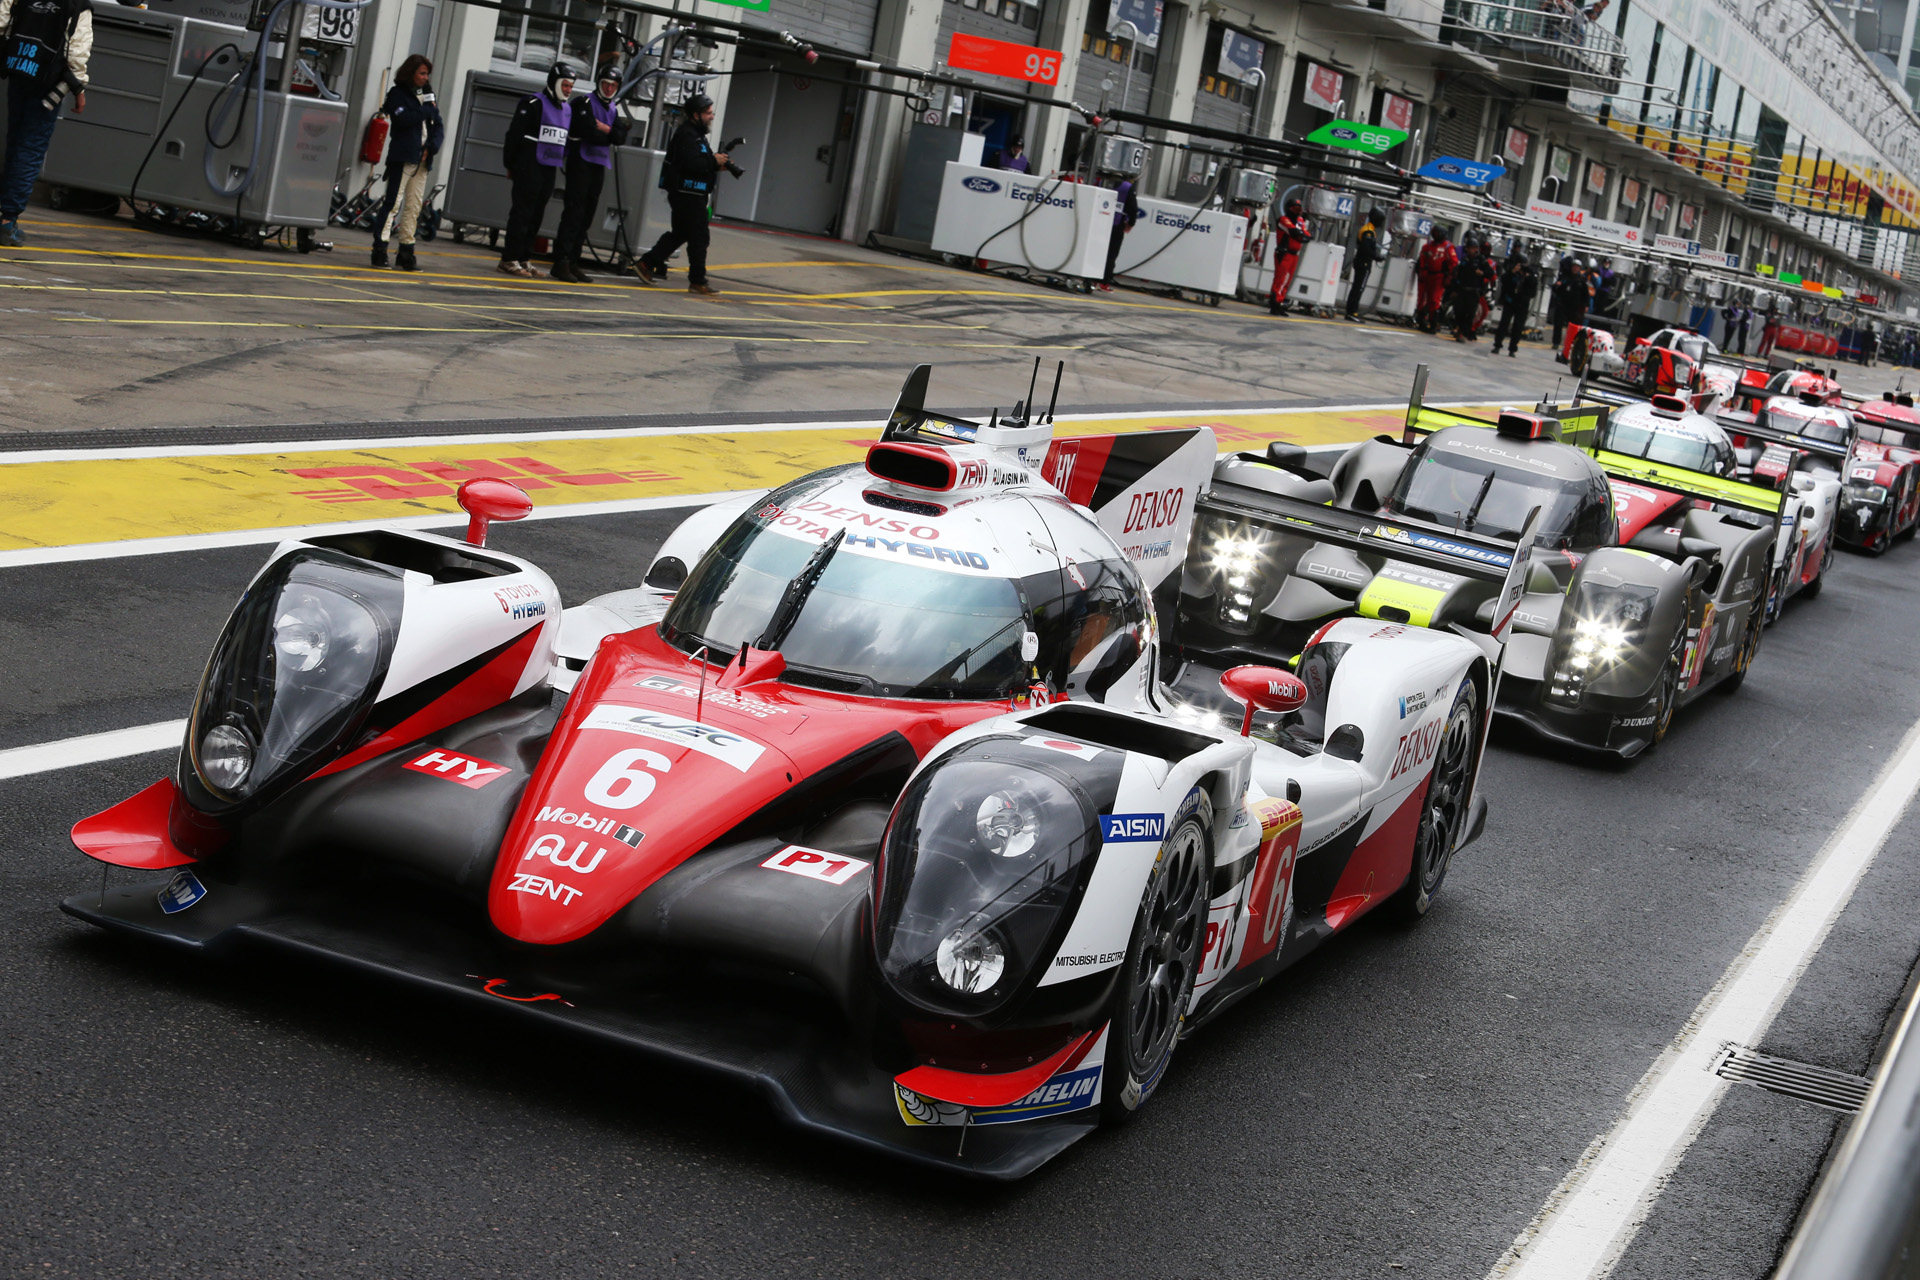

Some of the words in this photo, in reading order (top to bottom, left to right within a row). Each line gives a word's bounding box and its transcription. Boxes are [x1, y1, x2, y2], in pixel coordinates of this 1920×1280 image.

[199, 7, 226, 18] ASTON
[322, 8, 353, 39] 98
[17, 42, 38, 58] 108
[16, 57, 39, 77] LANE
[1024, 53, 1056, 80] 95
[542, 127, 557, 137] PIT
[1360, 131, 1391, 147] 66
[1464, 167, 1491, 180] 67
[1011, 188, 1075, 209] EcoBoost
[1012, 182, 1039, 192] Powered
[1041, 186, 1050, 195] by
[1157, 210, 1182, 219] Powered
[1338, 201, 1352, 215] 44
[1531, 205, 1562, 217] MANOR
[1566, 210, 1584, 226] 44
[1155, 215, 1211, 233] EcoBoost
[1419, 220, 1431, 235] 45
[1591, 224, 1620, 235] MANOR
[1624, 230, 1638, 241] 45
[1656, 238, 1687, 250] TOYOTA
[1689, 242, 1698, 255] 5
[1728, 256, 1736, 266] 6
[1447, 440, 1557, 471] BYKOLLES
[287, 457, 636, 501] DHL
[957, 459, 988, 489] ZENT
[1000, 473, 1018, 485] AISIN
[1019, 473, 1030, 484] AW
[1053, 453, 1077, 494] HY
[1855, 468, 1872, 478] P1
[797, 501, 940, 540] DENSO
[1123, 487, 1184, 534] DENSO
[754, 503, 830, 540] TOYOTA
[845, 533, 990, 570] HYBRID
[1123, 545, 1142, 562] OYOTA
[1142, 540, 1172, 560] HYBRID
[1414, 537, 1510, 565] MICHELIN
[500, 584, 541, 600] TOYOTA
[512, 601, 546, 620] HYBRID
[1513, 610, 1549, 627] mc
[636, 677, 699, 699] GR
[1268, 680, 1293, 698] Mobil
[703, 696, 769, 718] Racing
[710, 693, 777, 715] GAZOO
[719, 690, 790, 714] TOYOTA
[628, 715, 743, 747] WEC
[1621, 715, 1656, 727] DUNLOP
[1390, 717, 1442, 781] DENSO
[413, 751, 502, 780] HY
[584, 748, 672, 810] 6
[534, 806, 617, 835] Mobil
[1260, 800, 1302, 830] DHL
[1109, 819, 1162, 837] AISIN
[778, 850, 850, 877] P1
[507, 873, 583, 906] ZENT
[1263, 844, 1293, 944] 6
[1198, 918, 1229, 974] P1
[1056, 953, 1097, 967] MITSUBISHI
[1100, 950, 1126, 964] ELECTRIC
